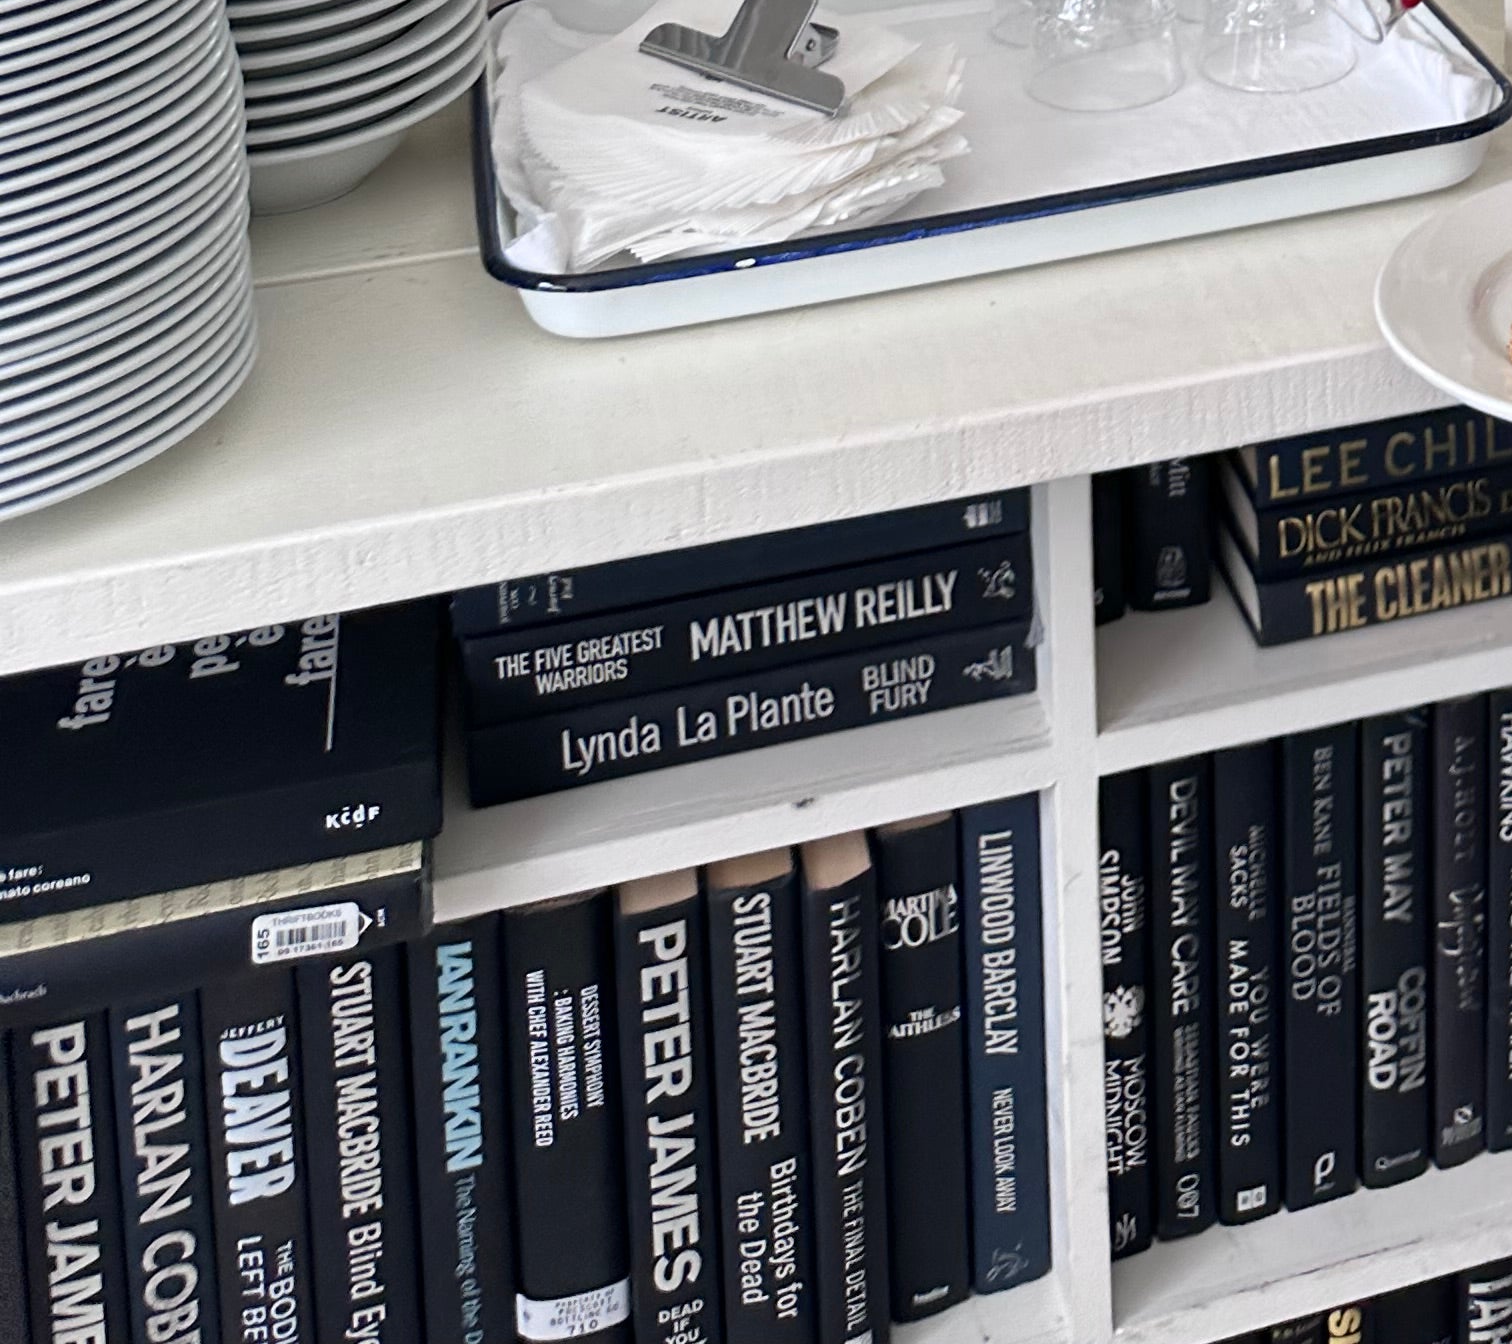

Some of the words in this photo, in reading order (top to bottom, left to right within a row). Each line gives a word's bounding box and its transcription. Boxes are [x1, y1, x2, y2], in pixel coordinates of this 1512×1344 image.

[655, 105, 729, 123] ARTIST
[1268, 436, 1371, 501] LEE
[1277, 506, 1365, 560] DICK
[1369, 476, 1494, 530] FRANCIS
[690, 592, 847, 662] MATTHEW
[855, 569, 959, 630] REILLY
[1305, 574, 1367, 638] THE
[1372, 542, 1512, 614] CLEANER
[495, 655, 531, 680] THE
[534, 643, 574, 671] FIVE
[576, 624, 664, 664] GREATEST
[535, 658, 629, 697] WARRIORS
[862, 654, 936, 694] BLIND
[561, 715, 662, 778] Lynda
[676, 704, 717, 749] La
[726, 679, 836, 739] Plante
[869, 678, 934, 715] FURY
[1311, 744, 1335, 791] BEN
[1381, 731, 1415, 848] PETER
[1168, 777, 1199, 864] DEVIL
[1311, 793, 1335, 858] KANE
[32, 873, 92, 896] coreano
[977, 829, 1015, 946] LINWOOD
[1100, 847, 1122, 967] SIMPSON
[1120, 873, 1146, 934] JOHN
[1170, 865, 1199, 930] MAY
[1228, 844, 1248, 910] SACKS
[1247, 823, 1269, 921] MICHELLE
[1382, 853, 1416, 924] MAY
[256, 927, 271, 960] 165
[732, 890, 775, 998] STUART
[1290, 892, 1318, 1003] BLOOD
[1314, 862, 1343, 968] FIELDS
[525, 968, 546, 1004] WITH
[829, 894, 865, 1051] HARLAN
[982, 946, 1020, 1057] BARCLAY
[1170, 932, 1200, 1018] CARE
[1228, 937, 1250, 1015] MADE
[1248, 965, 1270, 1025] YOU
[1316, 975, 1343, 1019] OF
[221, 1014, 286, 1040] JEFFERY
[329, 959, 378, 1068] STUART
[527, 1003, 548, 1039] CHEF
[556, 995, 576, 1047] BAKING
[581, 983, 602, 1044] DESSERT
[637, 918, 692, 1106] PETER
[908, 1005, 936, 1024] THE
[1367, 989, 1398, 1092] ROAD
[1396, 965, 1428, 1095] COFFIN
[529, 1035, 554, 1113] ALEXANDER
[558, 1044, 580, 1122] HARMONIES
[585, 1039, 606, 1110] SYMPHONY
[737, 997, 781, 1145] MACBRIDE
[1229, 1026, 1251, 1080] FOR
[1249, 1034, 1272, 1111] WERE
[31, 1019, 96, 1212] PETER
[126, 1002, 193, 1224] HARLAN
[219, 1026, 297, 1207] DEAVER
[336, 1069, 385, 1219] MACBRIDE
[535, 1109, 555, 1149] REED
[833, 1053, 869, 1178] COBEN
[992, 1086, 1016, 1134] NEVER
[1106, 1059, 1126, 1177] MIDNIGHT
[1229, 1089, 1252, 1149] THIS
[993, 1133, 1017, 1173] LOOK
[647, 1112, 702, 1293] JAMES
[736, 1189, 761, 1236] the
[769, 1156, 800, 1279] Birthdays
[839, 1179, 863, 1220] THE
[993, 1171, 1018, 1213] AWAY
[236, 1234, 265, 1299] LEFT
[274, 1239, 295, 1276] THE
[348, 1219, 386, 1301] Blind
[736, 1237, 771, 1307] Dead
[841, 1216, 866, 1259] FINAL
[566, 1318, 600, 1336] 710
[656, 1297, 704, 1325] DEAD
[672, 1318, 692, 1336] IF
[773, 1280, 799, 1321] for
[841, 1256, 871, 1332] DETAIL
